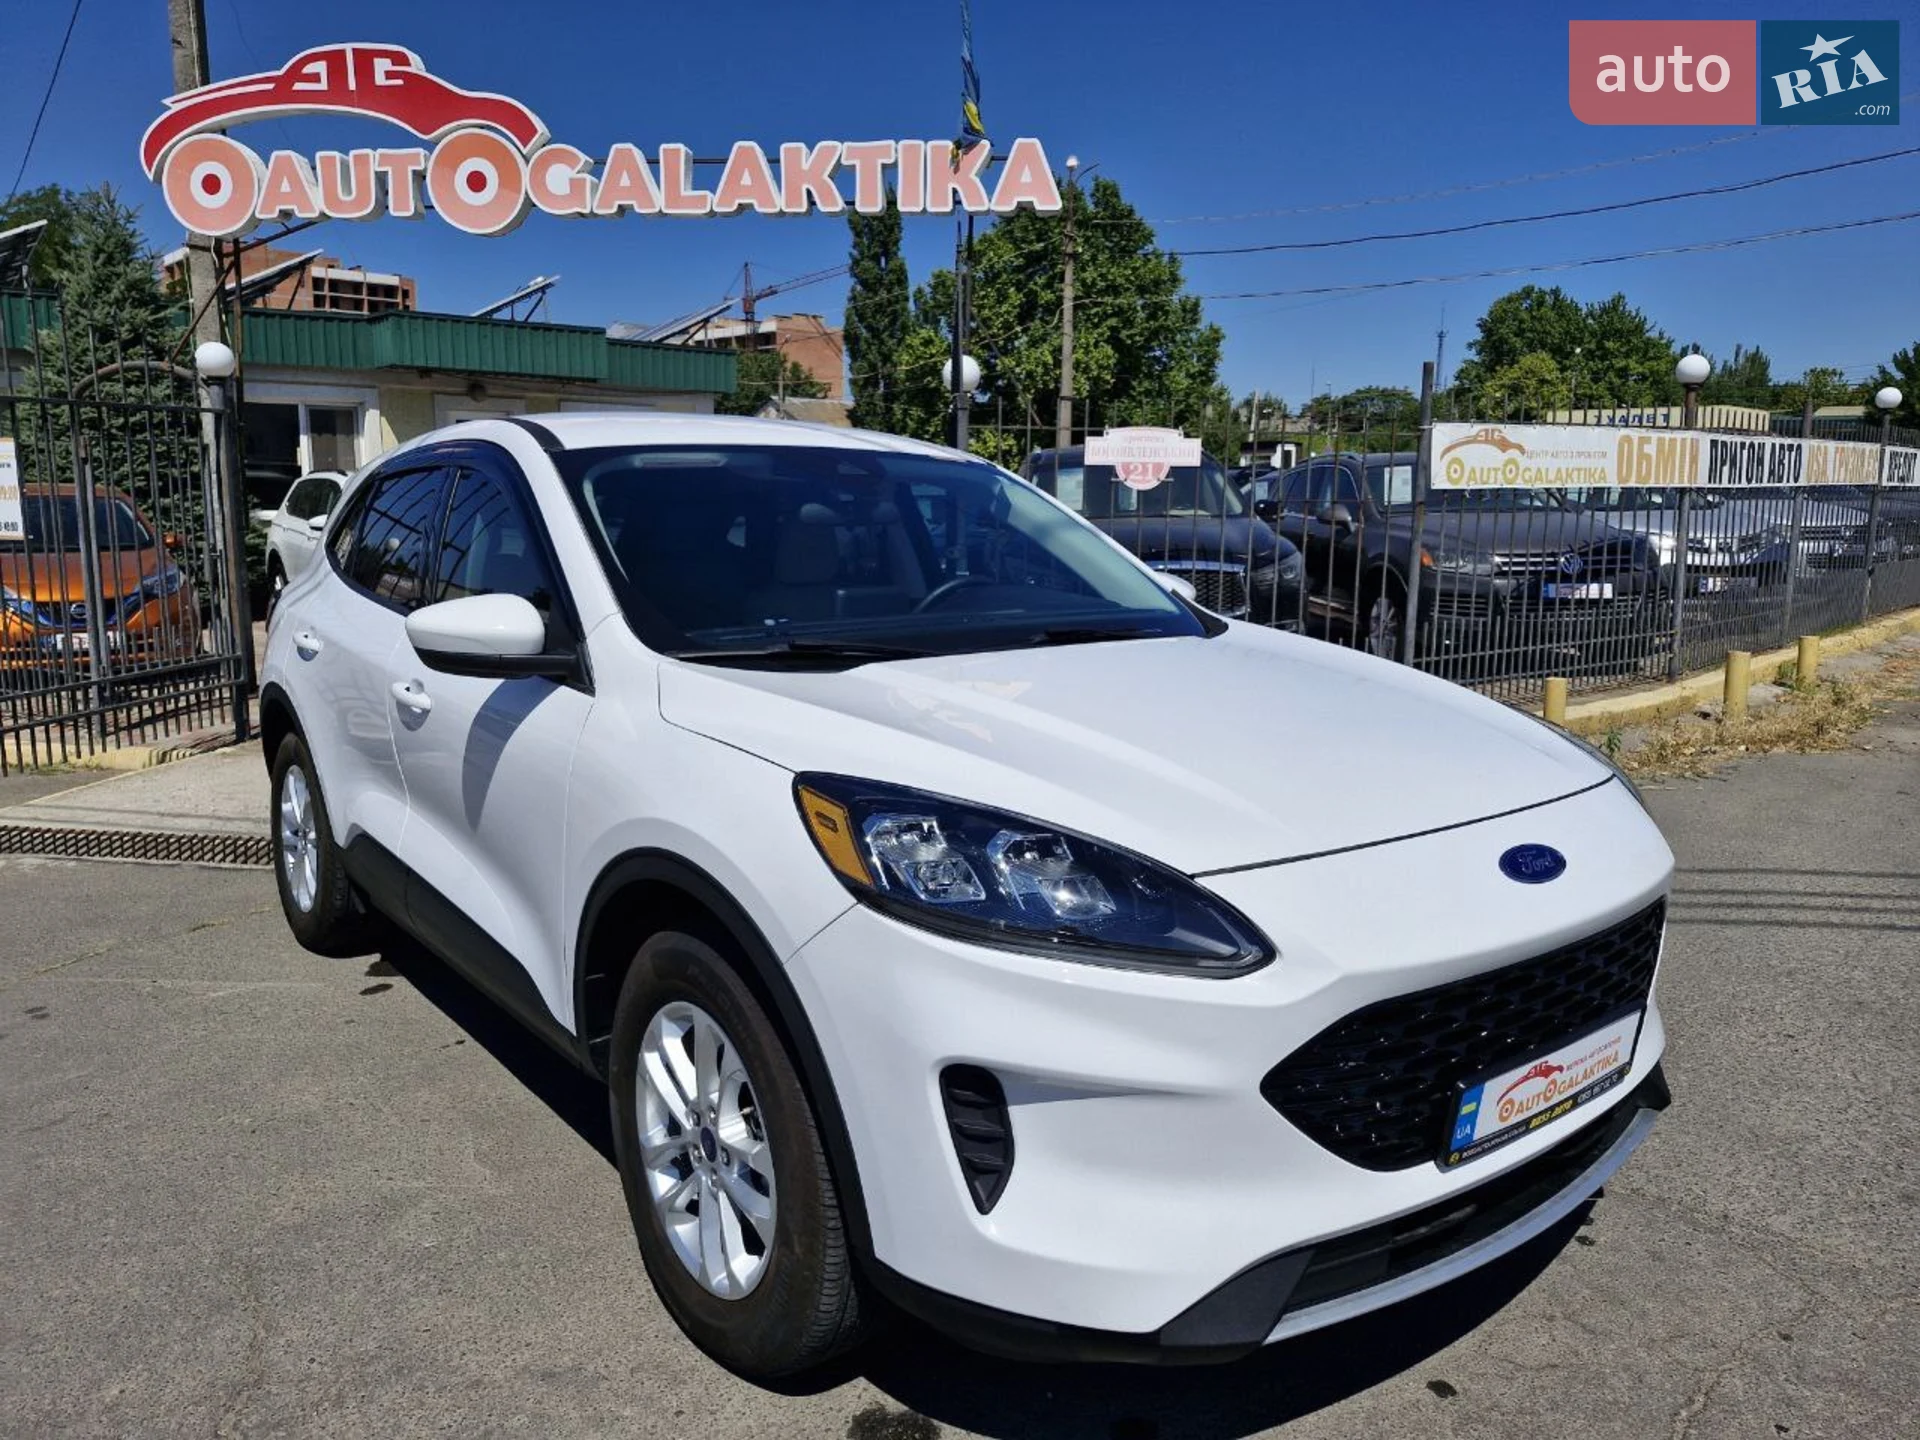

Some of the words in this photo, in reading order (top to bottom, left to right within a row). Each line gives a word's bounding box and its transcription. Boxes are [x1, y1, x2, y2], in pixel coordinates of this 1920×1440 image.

[1616, 434, 1701, 486] ОБМІН
[1707, 439, 1764, 485] ПРИГОН
[1767, 442, 1802, 484] АВТО
[1129, 462, 1154, 480] 21
[1516, 850, 1558, 875] Ford
[1456, 1126, 1471, 1140] UA
